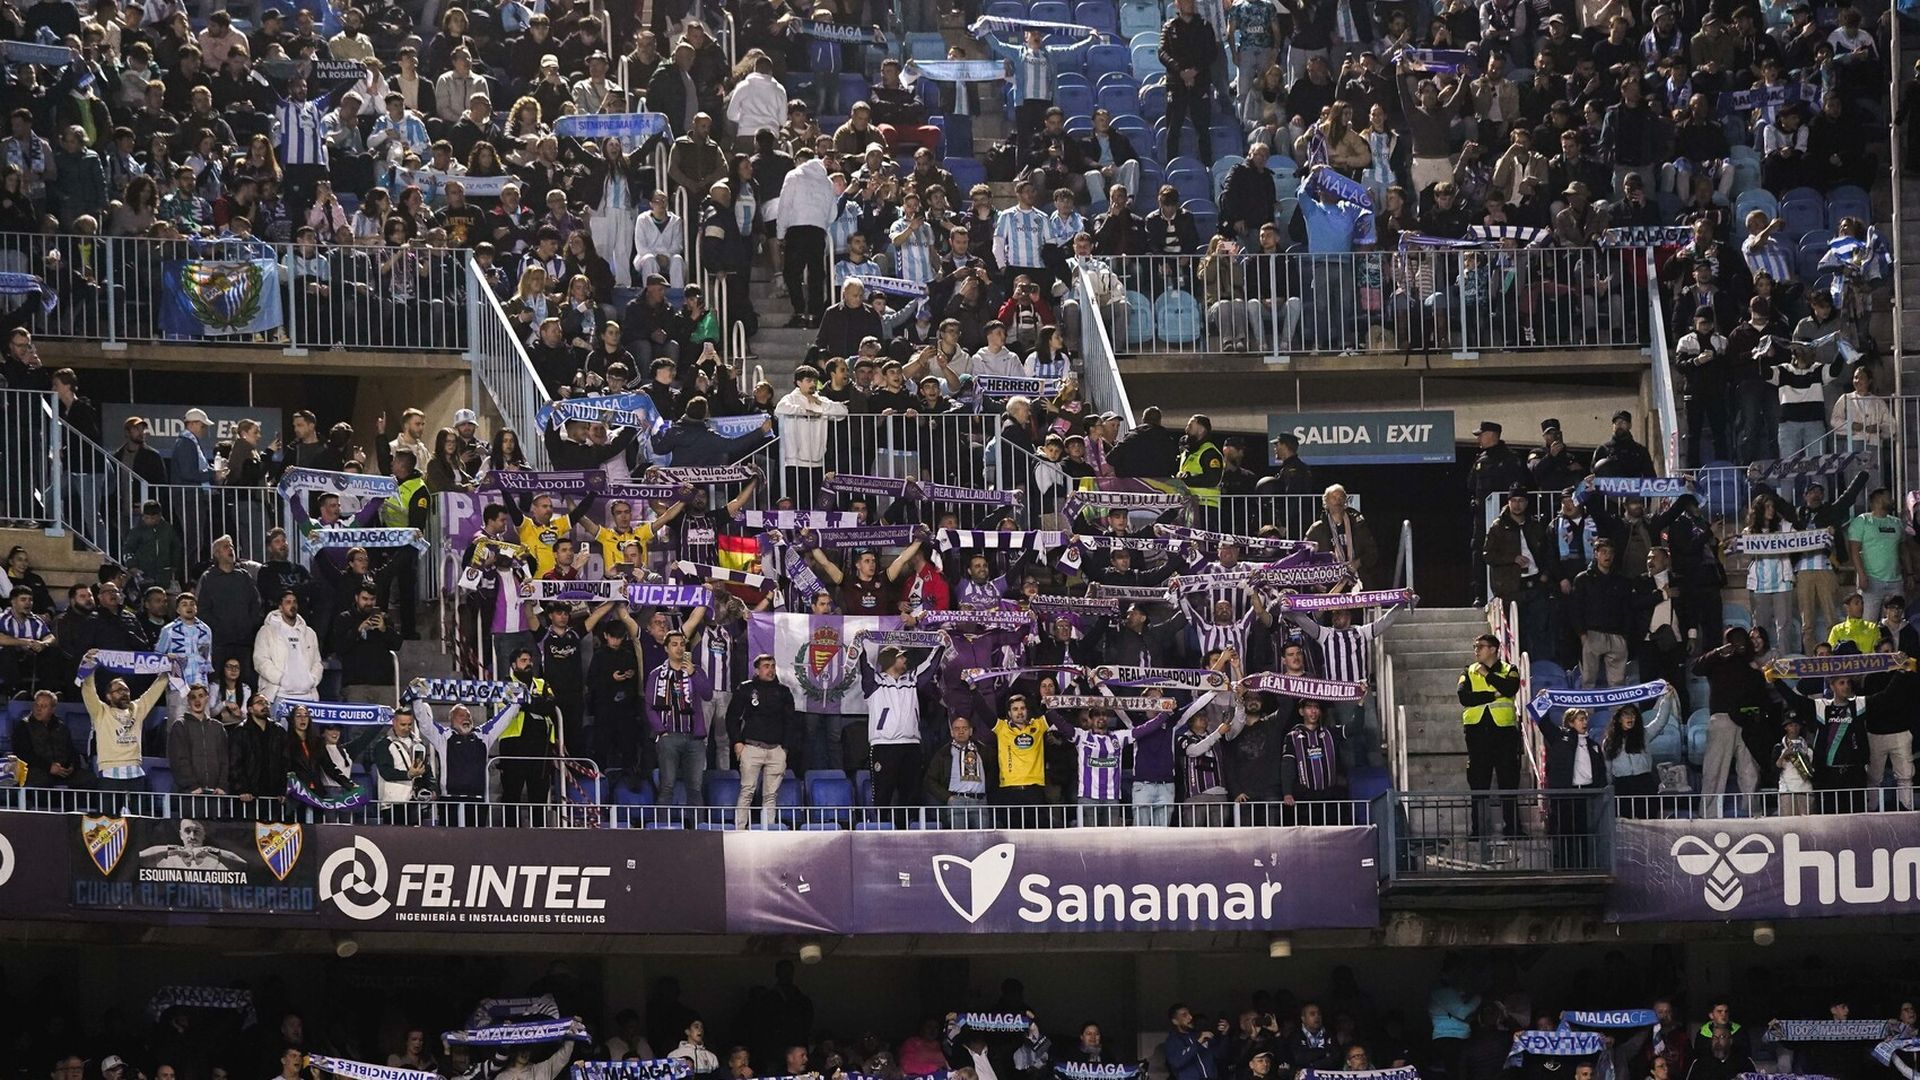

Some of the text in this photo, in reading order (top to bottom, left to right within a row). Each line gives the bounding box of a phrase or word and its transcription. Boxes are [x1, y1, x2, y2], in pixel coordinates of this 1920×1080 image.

[814, 23, 862, 37] MALAGA
[316, 60, 357, 71] MALAGA
[316, 71, 327, 79] LA
[579, 119, 651, 131] SIEMPRE MALAGA
[1317, 174, 1373, 208] MÁLAG
[1621, 228, 1690, 244] MALAGA
[987, 378, 1040, 392] HERRERO
[143, 418, 186, 437] ALID
[1293, 424, 1433, 445] SALIDA EXIT
[498, 472, 534, 482] REAL
[352, 479, 396, 491] MALAG
[500, 480, 586, 490] VALLADOLID
[862, 487, 889, 495] PRIMERA
[1600, 478, 1680, 493] MALAGA
[933, 487, 1002, 500] REAL VALLADOLID
[328, 531, 403, 543] MALAGACF
[867, 539, 896, 547] PRIMERA
[1745, 533, 1829, 551] INVENCIBLES
[1211, 573, 1251, 583] VALLA
[542, 582, 611, 598] REAL VALLADOLID
[1295, 594, 1354, 608] FEDERACIÓN
[1354, 593, 1368, 604] DE
[99, 654, 169, 669] MALAGA
[1119, 667, 1201, 688] REAL VALLADOLID
[431, 682, 502, 699] MALAGA
[1259, 674, 1356, 697] REAL VALLADOLID
[1553, 688, 1644, 704] PORQUE TE QUIERO
[327, 710, 337, 719] TE
[339, 709, 375, 721] QUIERO
[91, 831, 112, 851] MALAGA
[264, 836, 286, 856] MALAGA
[139, 868, 248, 885] ESQUINA MALAGUISTA
[396, 864, 611, 909] FB.INTEC
[1018, 873, 1282, 923] Sanamar
[395, 911, 606, 923] INGENIERÍA E INSTALACIONES TÉCNICAS
[966, 1012, 1023, 1025] MALAGA
[1574, 1011, 1648, 1025] MALAGACF
[1790, 1023, 1881, 1036] 100% MALAGUISTA
[603, 1063, 674, 1080] MALAGA
[1065, 1061, 1127, 1075] MALAGA
